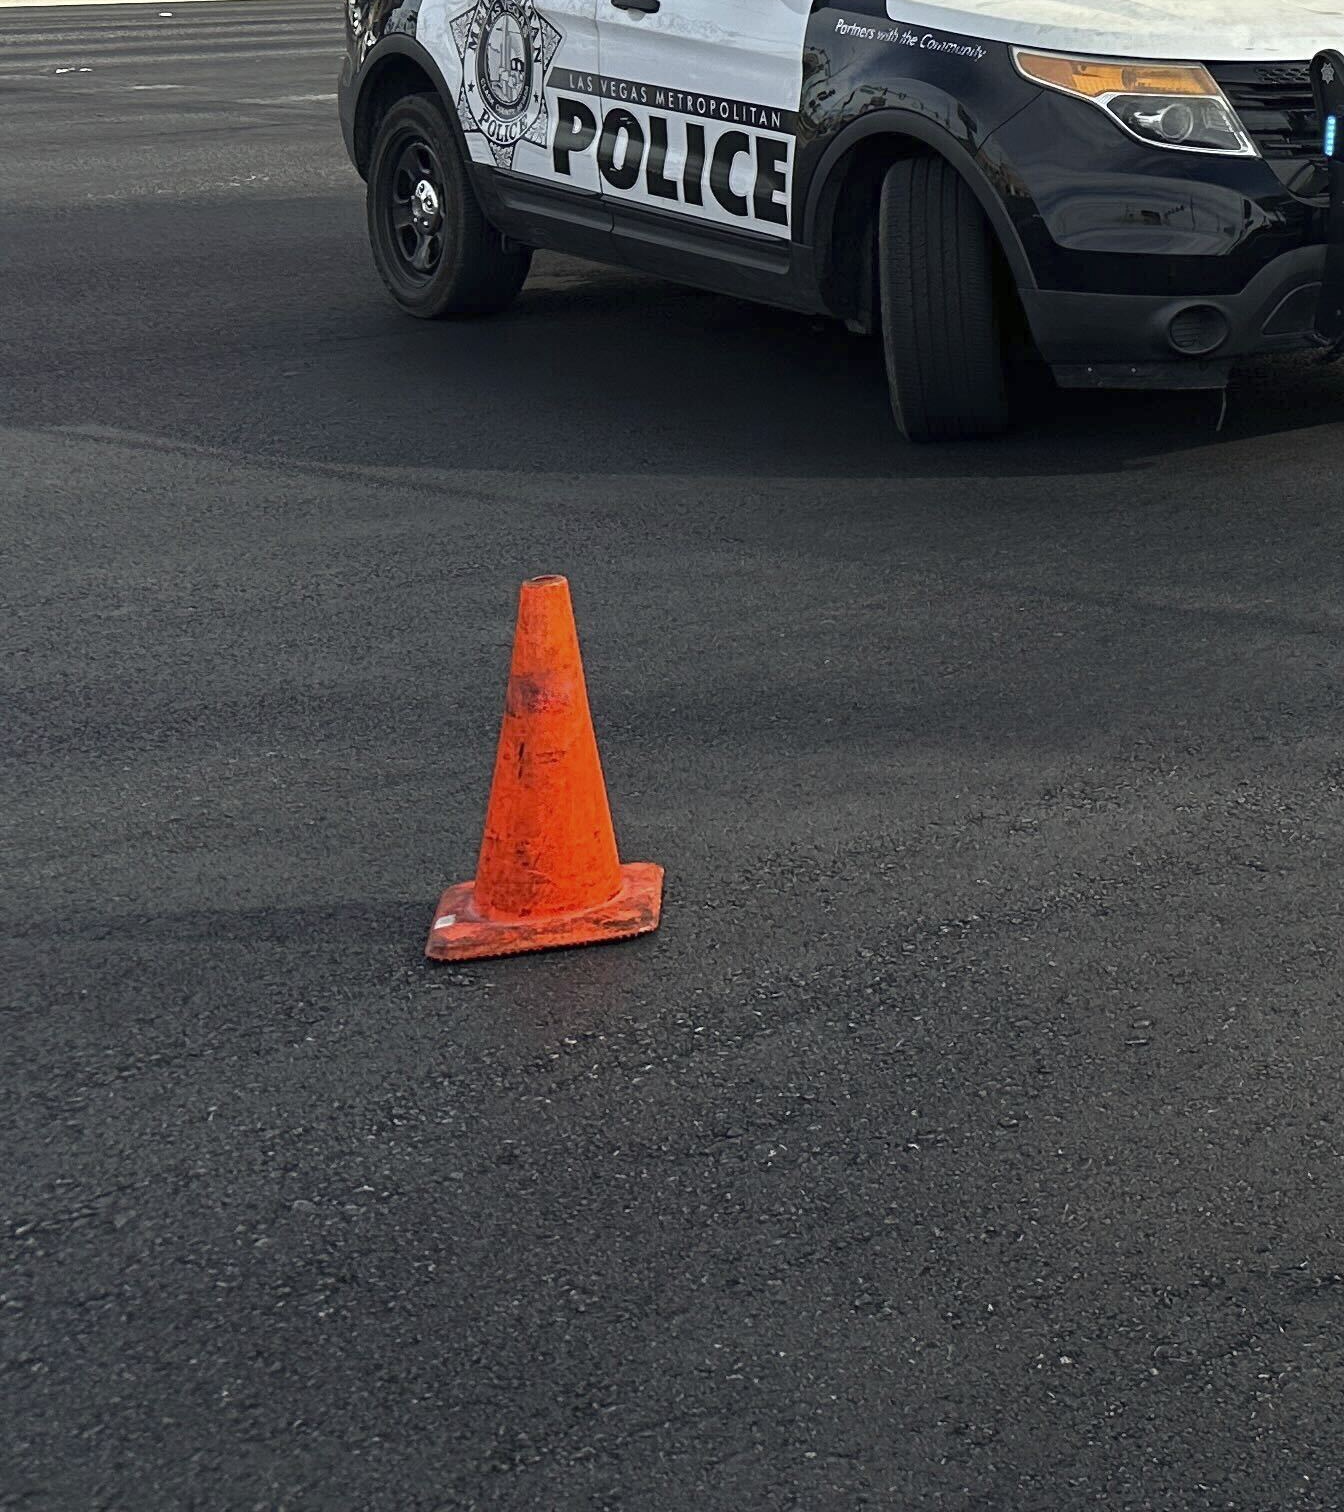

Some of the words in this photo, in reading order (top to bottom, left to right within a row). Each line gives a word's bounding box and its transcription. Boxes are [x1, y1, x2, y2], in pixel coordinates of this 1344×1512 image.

[834, 18, 876, 40] Partners
[876, 26, 899, 43] with
[899, 29, 918, 48] the
[919, 33, 988, 63] Community
[478, 107, 529, 143] POLICE
[569, 73, 593, 92] LAS
[600, 80, 648, 104] VEGAS
[655, 90, 782, 128] METROPOLITAN
[553, 96, 788, 227] POLICE
